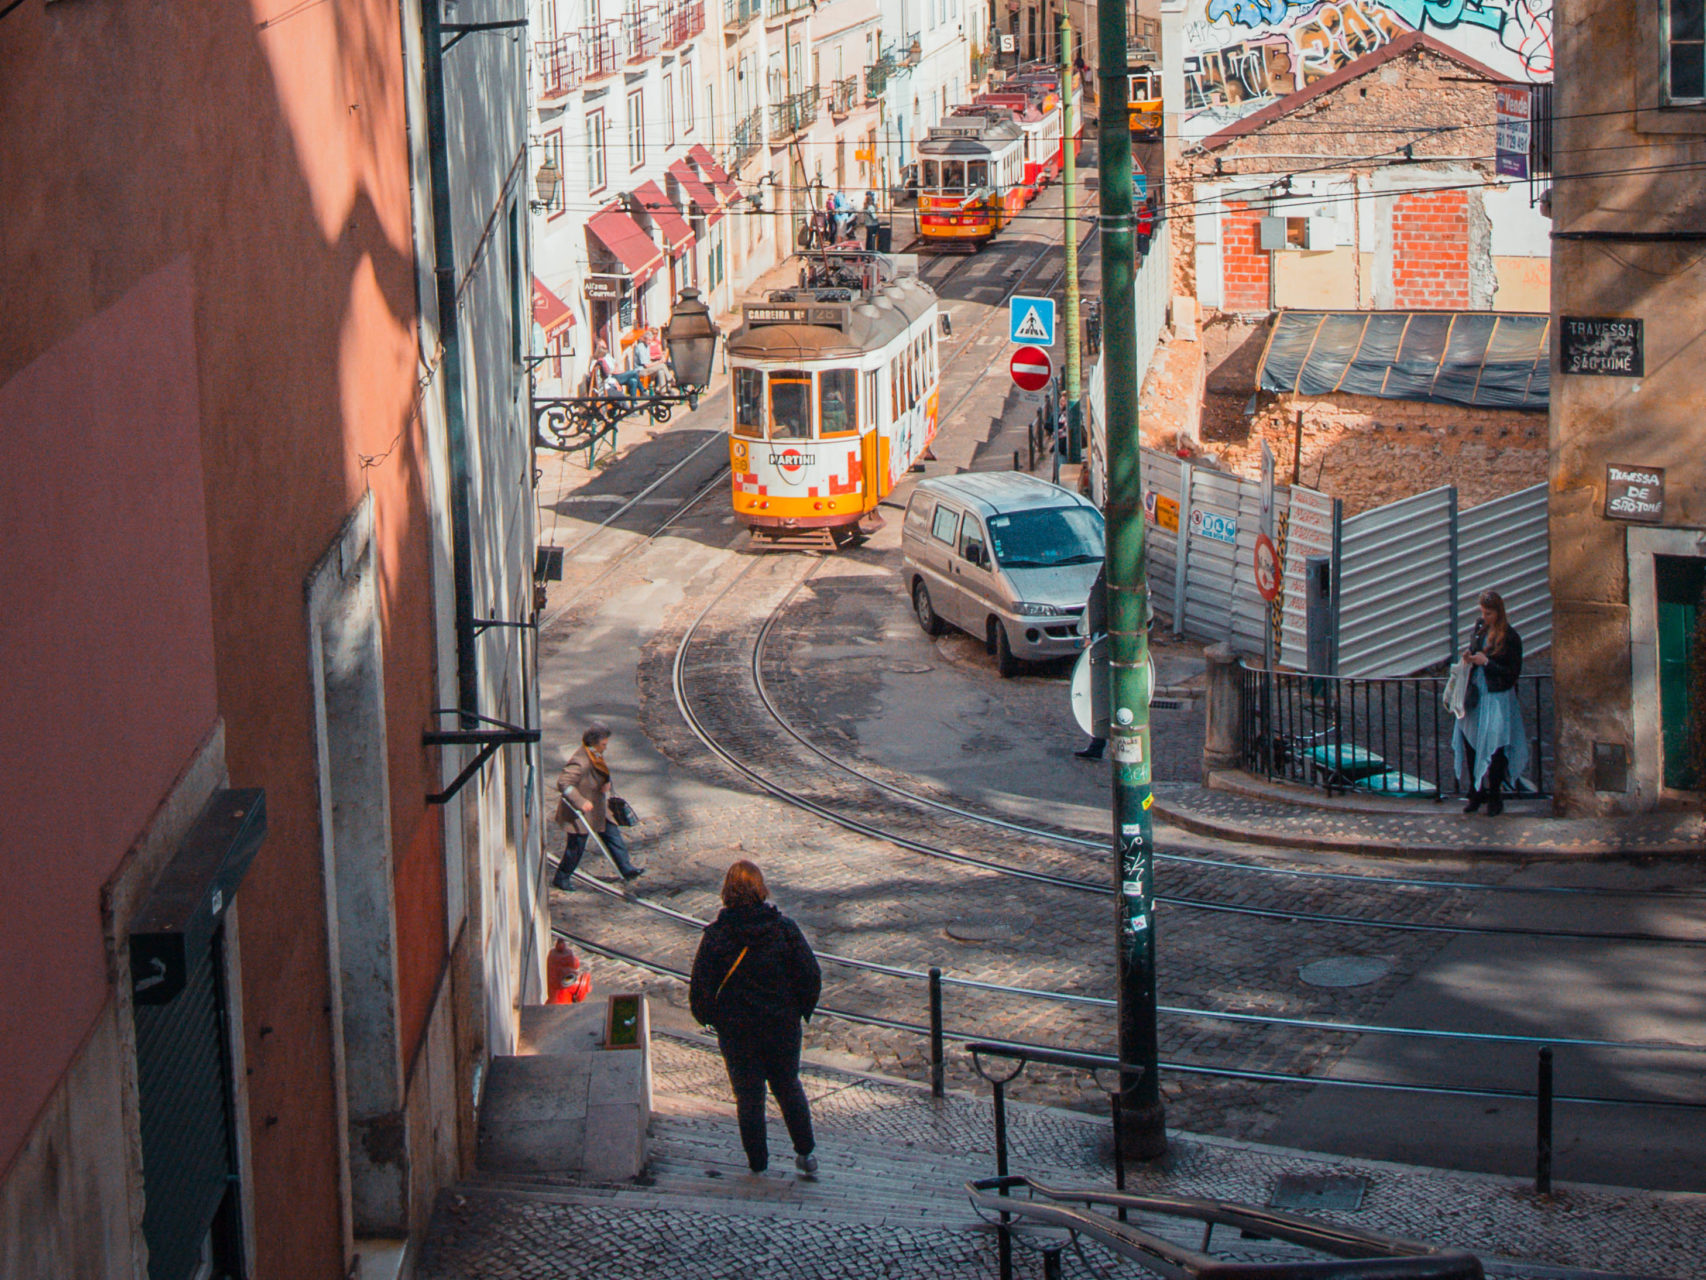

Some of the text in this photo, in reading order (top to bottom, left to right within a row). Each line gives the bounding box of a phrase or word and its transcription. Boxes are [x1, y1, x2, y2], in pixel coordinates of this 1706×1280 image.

[1505, 93, 1528, 115] Vende
[748, 310, 790, 320] CARREIRA
[1569, 321, 1634, 338] TRAVESSA
[769, 454, 815, 465] MARTINI
[1627, 485, 1650, 500] DE
